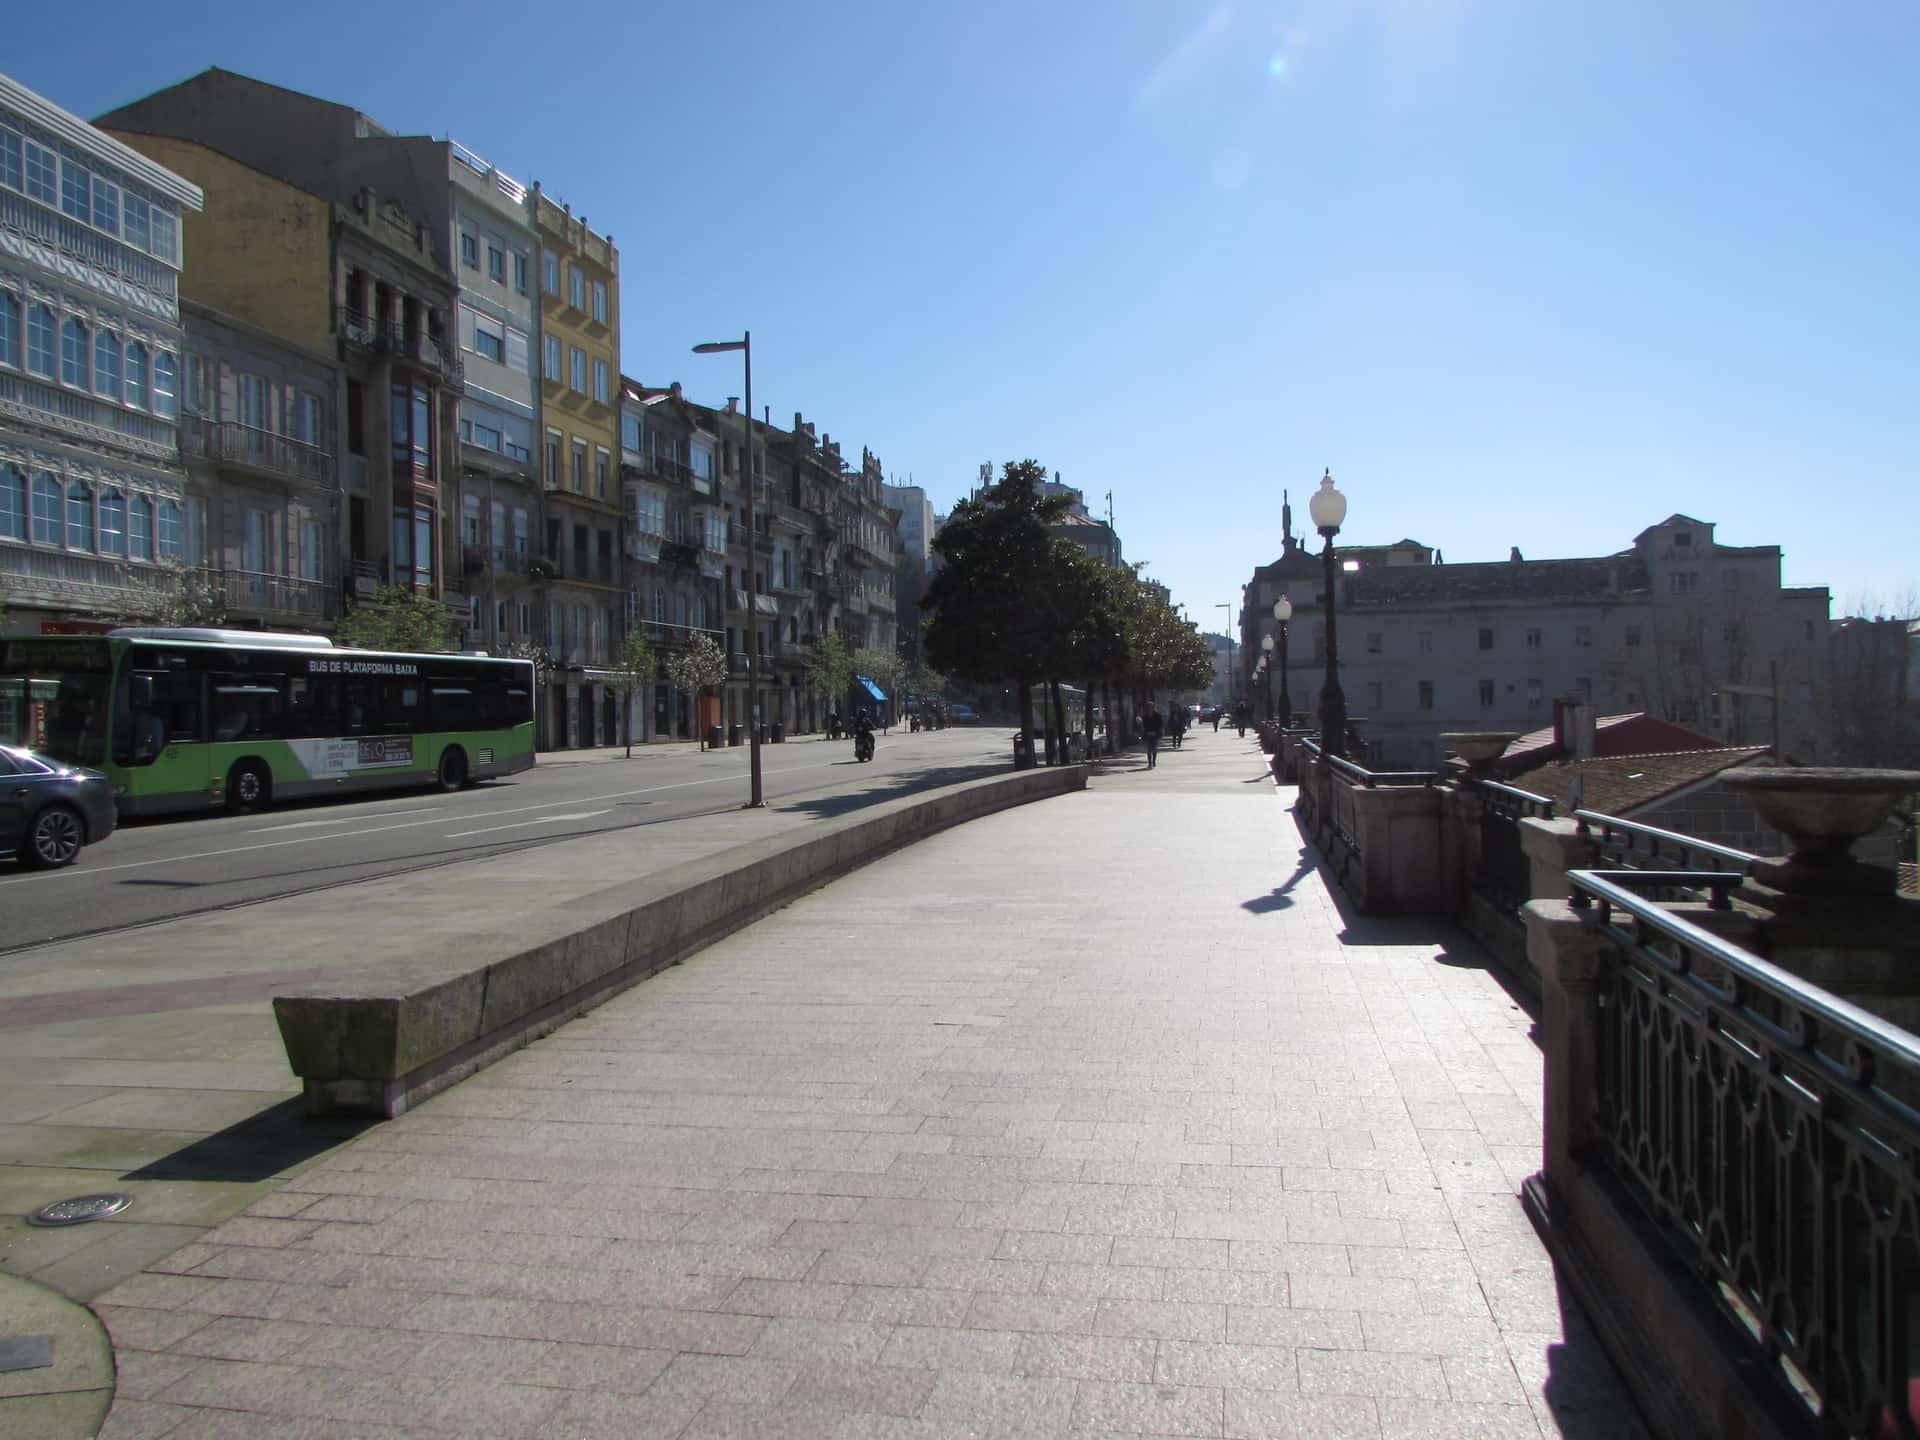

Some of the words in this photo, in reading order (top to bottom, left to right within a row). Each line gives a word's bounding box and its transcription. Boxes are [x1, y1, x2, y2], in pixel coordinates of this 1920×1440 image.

[309, 660, 328, 672] BUS
[329, 661, 341, 673] DE
[343, 662, 394, 674] PLATAFORMA
[395, 664, 418, 675] BAIXA
